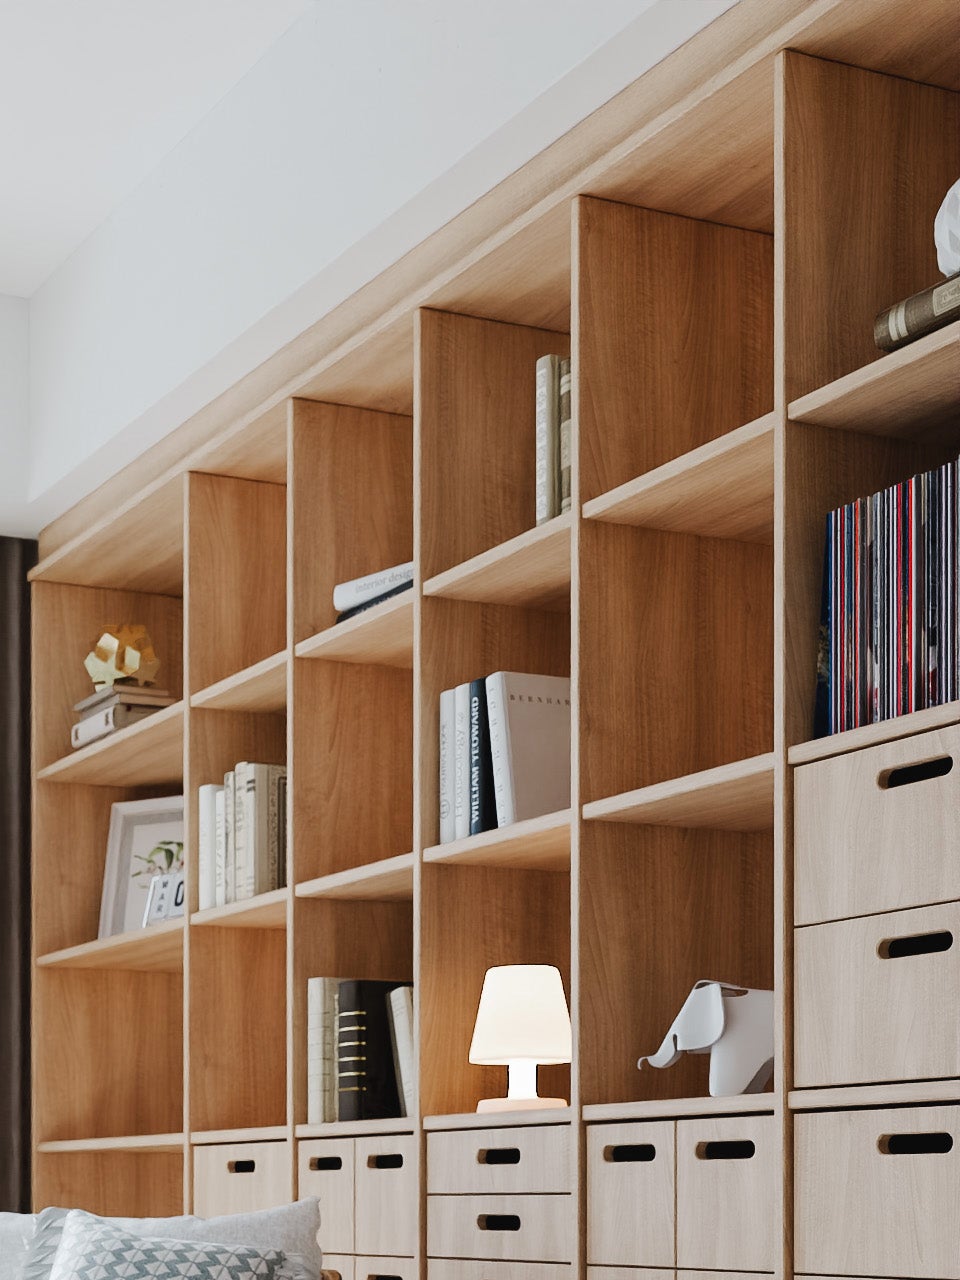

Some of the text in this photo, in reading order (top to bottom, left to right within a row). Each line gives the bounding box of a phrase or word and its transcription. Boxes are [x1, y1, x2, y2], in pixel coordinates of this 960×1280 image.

[356, 576, 388, 593] interior
[471, 696, 480, 824] WILLIAM YEOWARD
